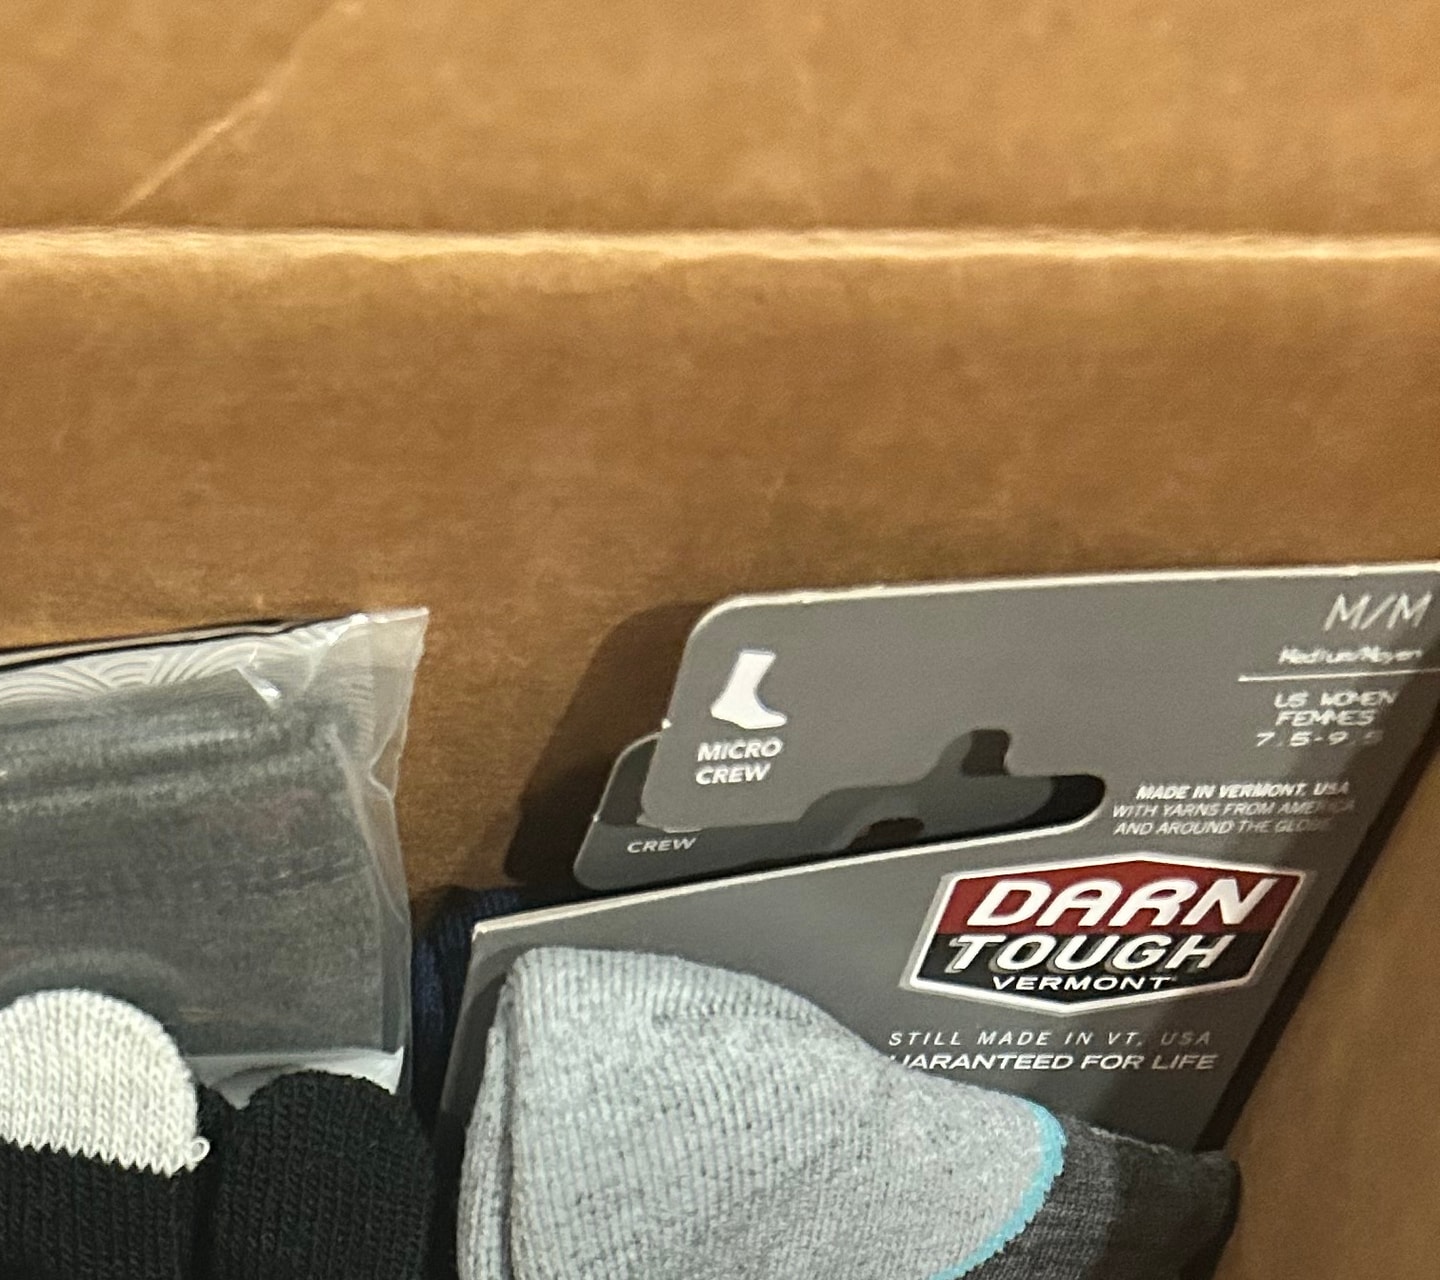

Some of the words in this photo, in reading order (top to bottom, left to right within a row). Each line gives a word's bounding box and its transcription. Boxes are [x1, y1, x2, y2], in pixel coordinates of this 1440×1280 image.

[1323, 591, 1433, 632] M/M
[696, 738, 784, 762] MICRO
[695, 761, 772, 786] CREW
[1135, 784, 1192, 801] MADE
[1191, 784, 1217, 800] IN
[1112, 803, 1160, 819] WITH
[1162, 802, 1220, 818] YARNS
[1221, 801, 1276, 817] FROM
[1112, 820, 1155, 836] AND
[1155, 819, 1236, 836] AROUND
[626, 834, 699, 855] CREW
[967, 876, 1269, 931] DARN
[949, 932, 1240, 976] TOUGH
[991, 974, 1174, 994] VERMONT
[888, 1030, 964, 1047] STILL
[975, 1031, 1054, 1047] MADE
[1062, 1031, 1095, 1047] IN
[1159, 1030, 1213, 1047] USA
[1079, 1054, 1145, 1071] FOR
[1150, 1053, 1220, 1071] LIFE
